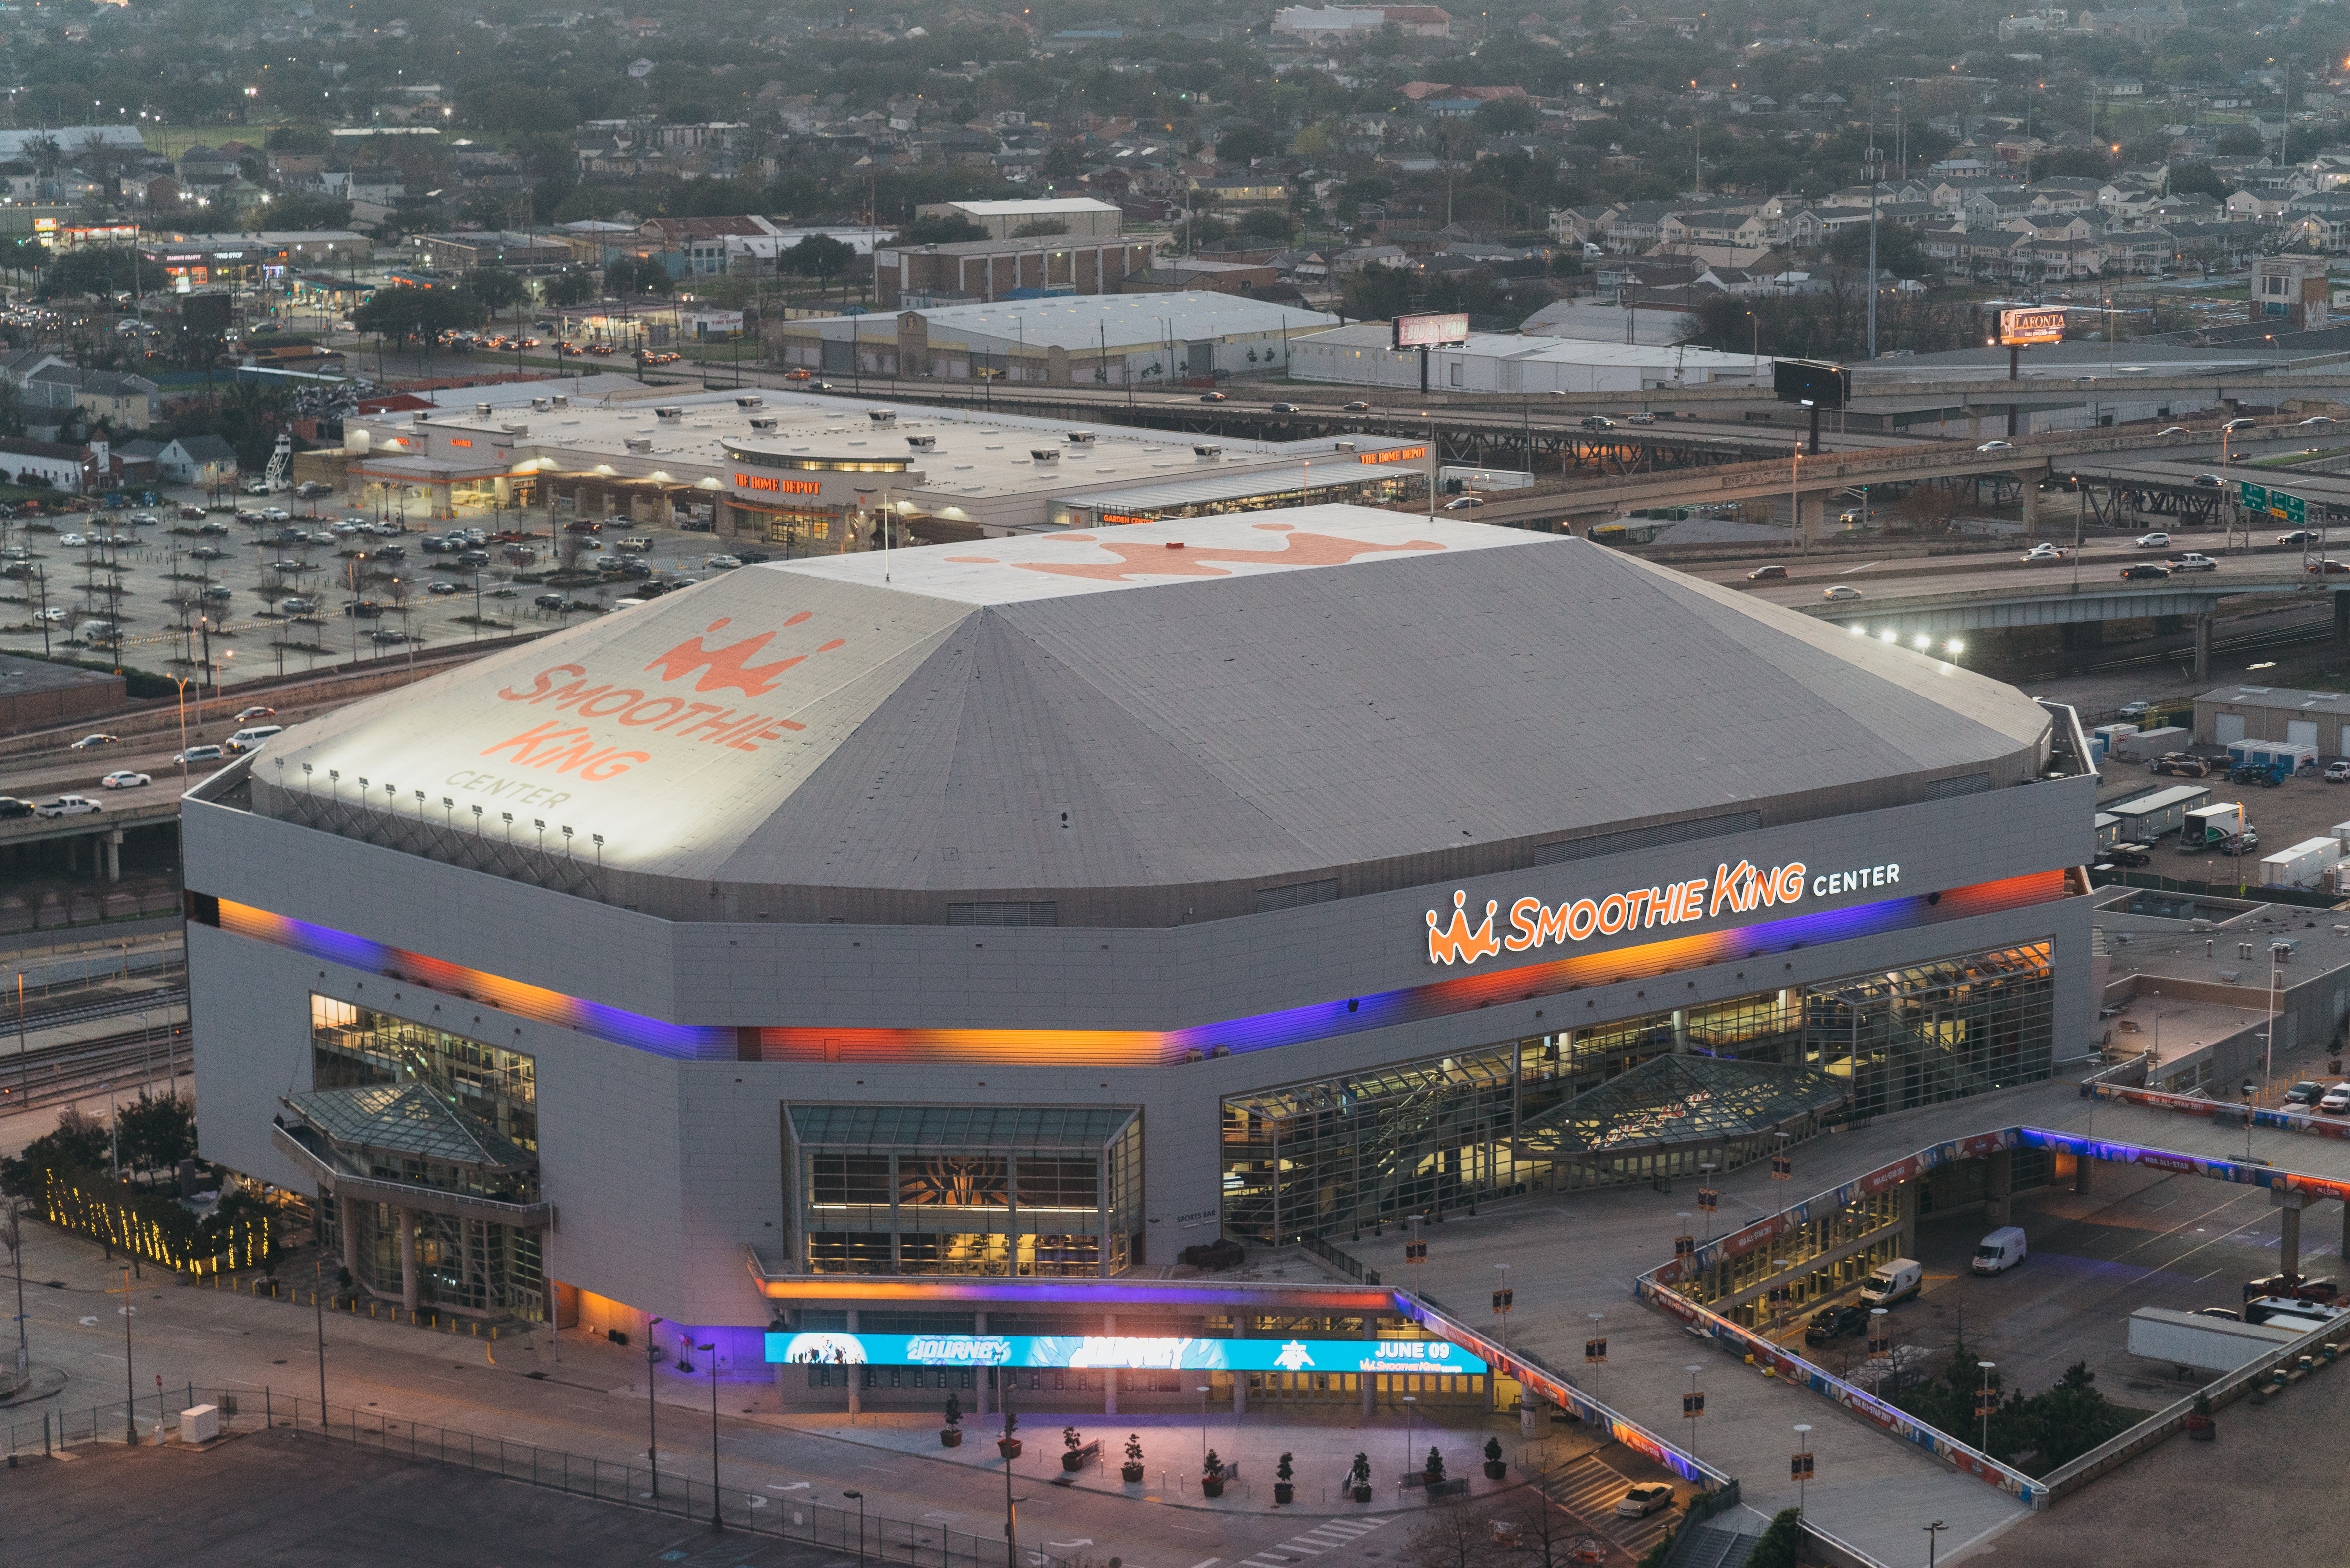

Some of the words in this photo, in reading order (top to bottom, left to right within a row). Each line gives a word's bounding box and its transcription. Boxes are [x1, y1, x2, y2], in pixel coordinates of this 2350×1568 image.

[2015, 314, 2065, 329] LAFONTA
[451, 439, 471, 447] LUMBER
[1360, 454, 1376, 464] THE
[1378, 451, 1400, 463] HOME
[1402, 447, 1426, 460] DEPOT
[735, 473, 748, 487] THE
[751, 476, 779, 491] HOME
[783, 480, 821, 494] DEPOT
[1104, 514, 1130, 523] GARDEN
[498, 664, 806, 751] SMOOTHIE
[445, 770, 571, 809] CENTER
[1504, 878, 1709, 952] SMOOTHIE
[1813, 863, 1900, 897] CENTER
[1177, 1213, 1201, 1223] SPORTS
[907, 1340, 1010, 1361] JOURNEY
[1375, 1342, 1424, 1358] JUNE
[1429, 1343, 1450, 1359] 09
[1376, 1361, 1419, 1371] SMOOTHIE
[1852, 1396, 1861, 1408] NBA
